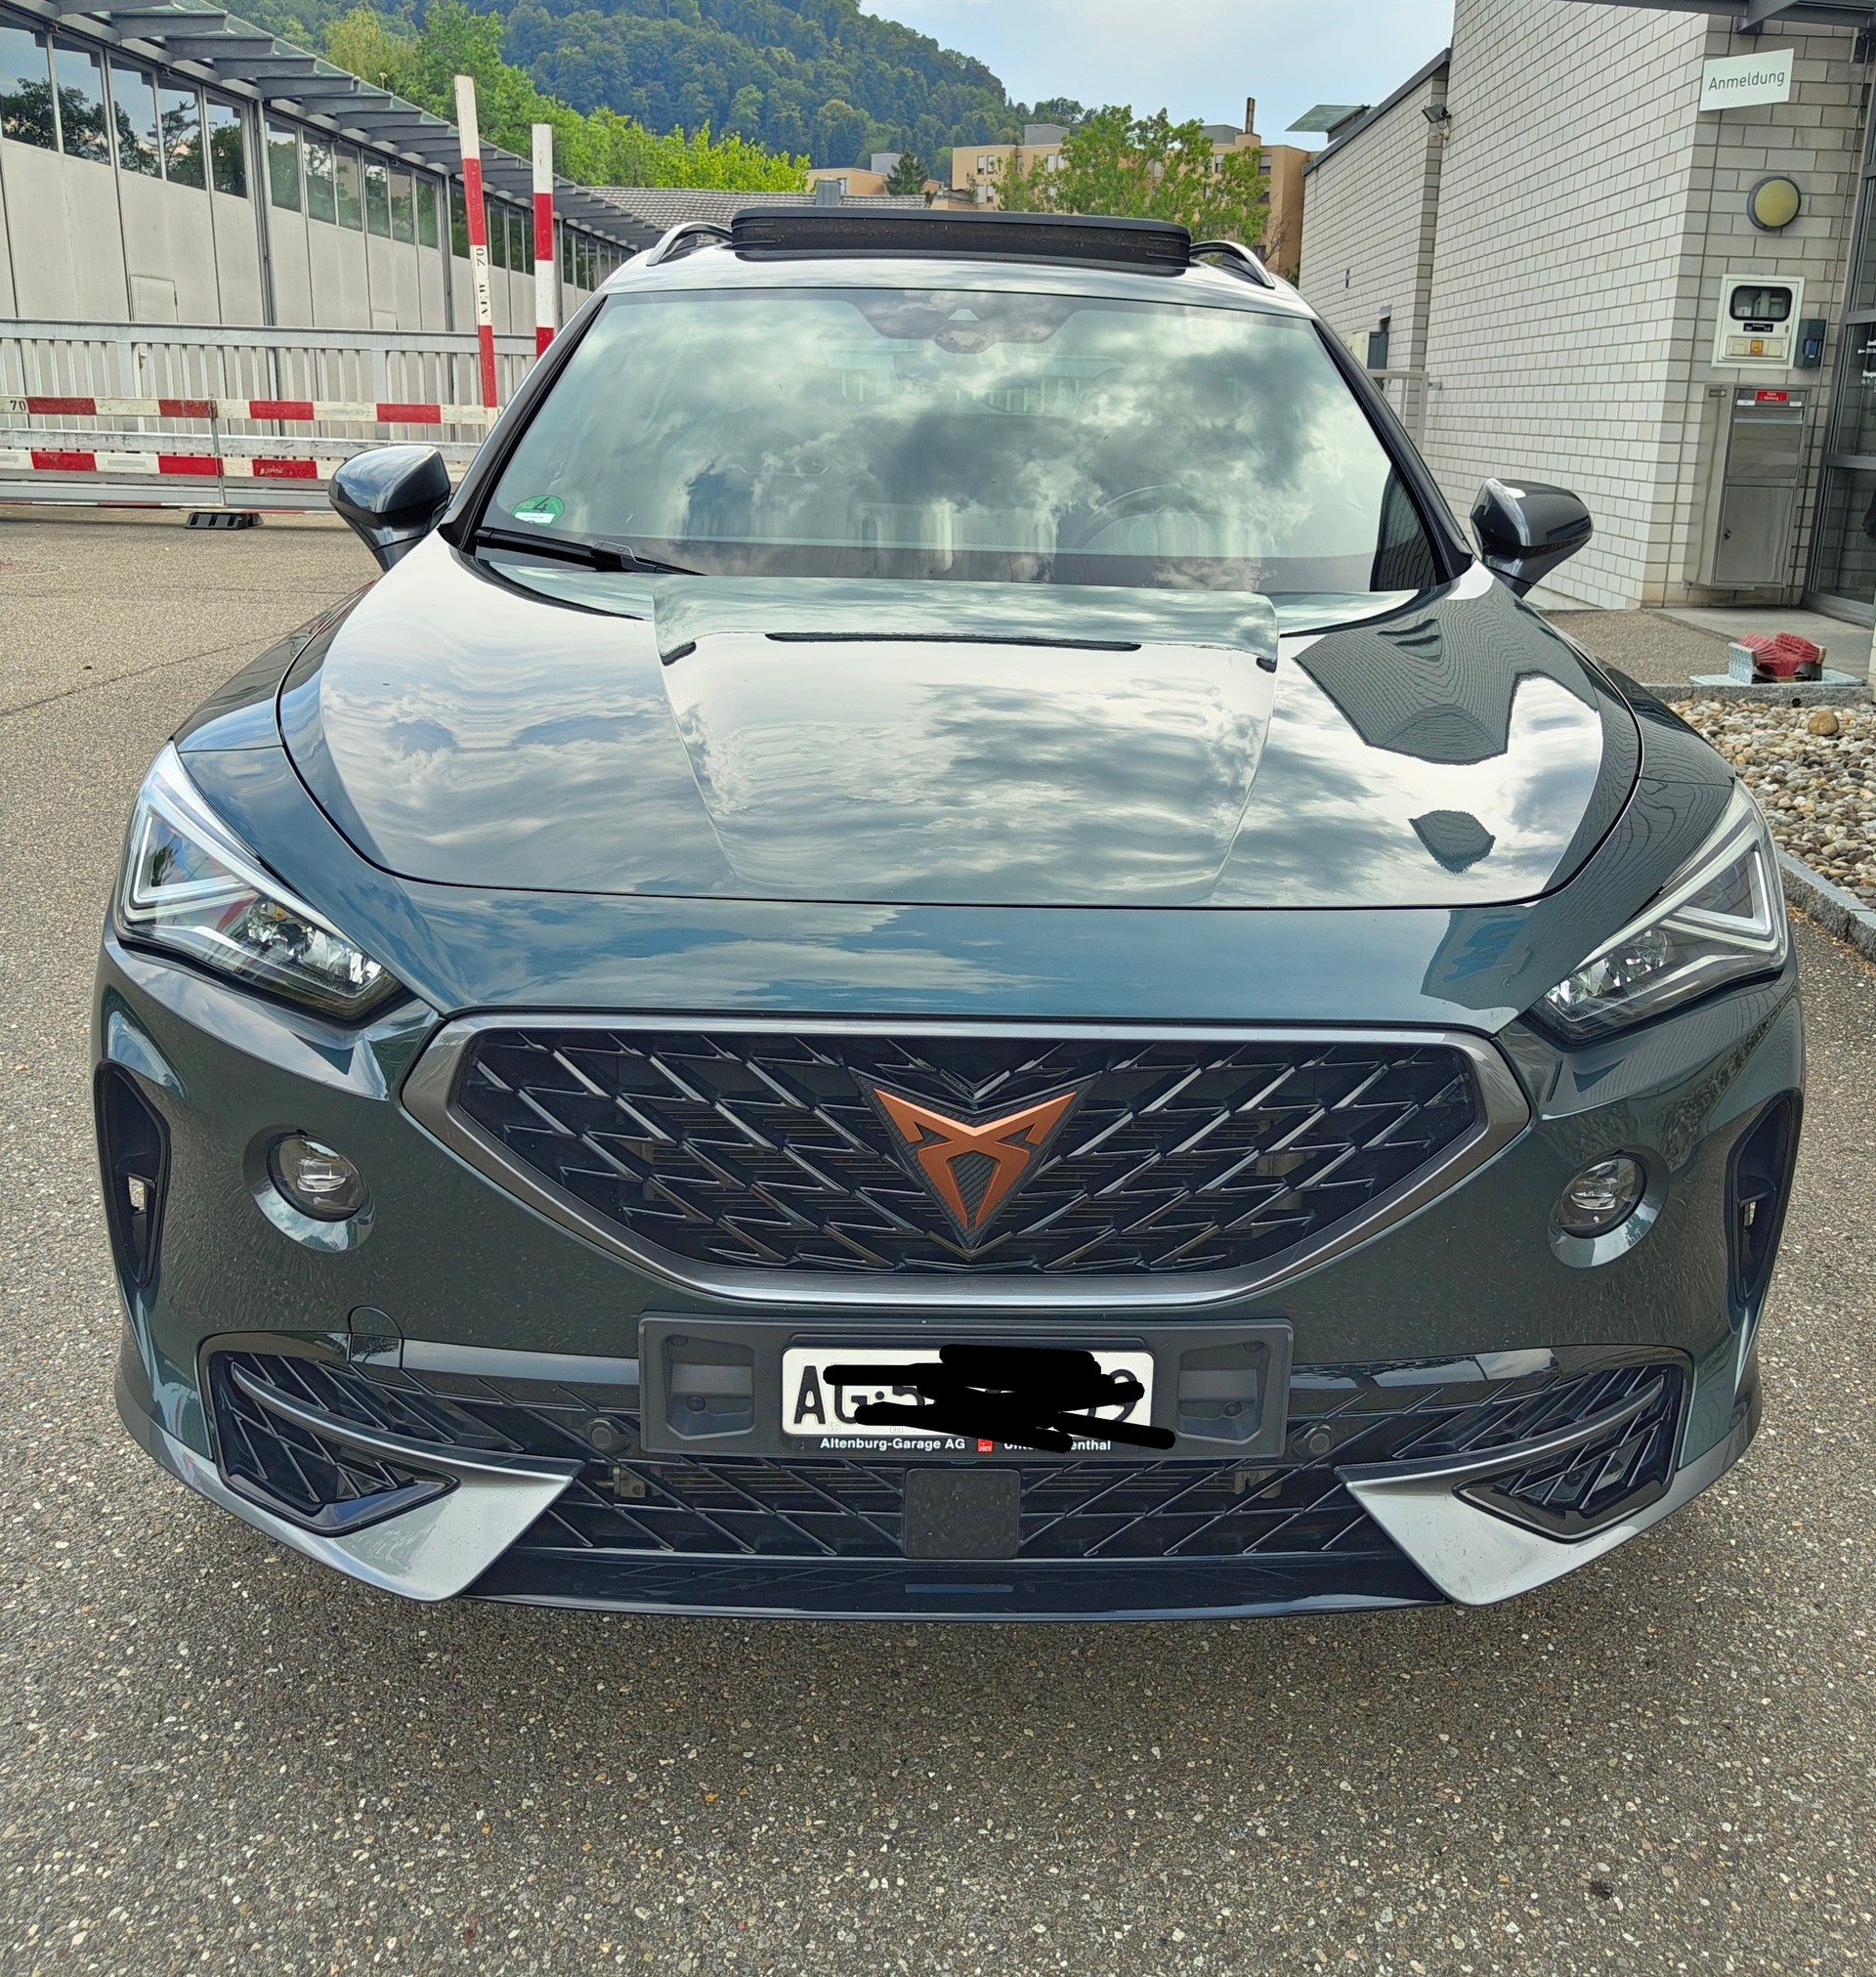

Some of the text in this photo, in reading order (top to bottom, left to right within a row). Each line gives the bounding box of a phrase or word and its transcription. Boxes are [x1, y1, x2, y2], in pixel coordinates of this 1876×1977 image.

[1708, 71, 1785, 92] Anmeldung
[10, 400, 26, 411] 70
[532, 496, 550, 512] 4
[820, 1438, 941, 1451] Altenburg-Garage
[944, 1439, 965, 1449] AG
